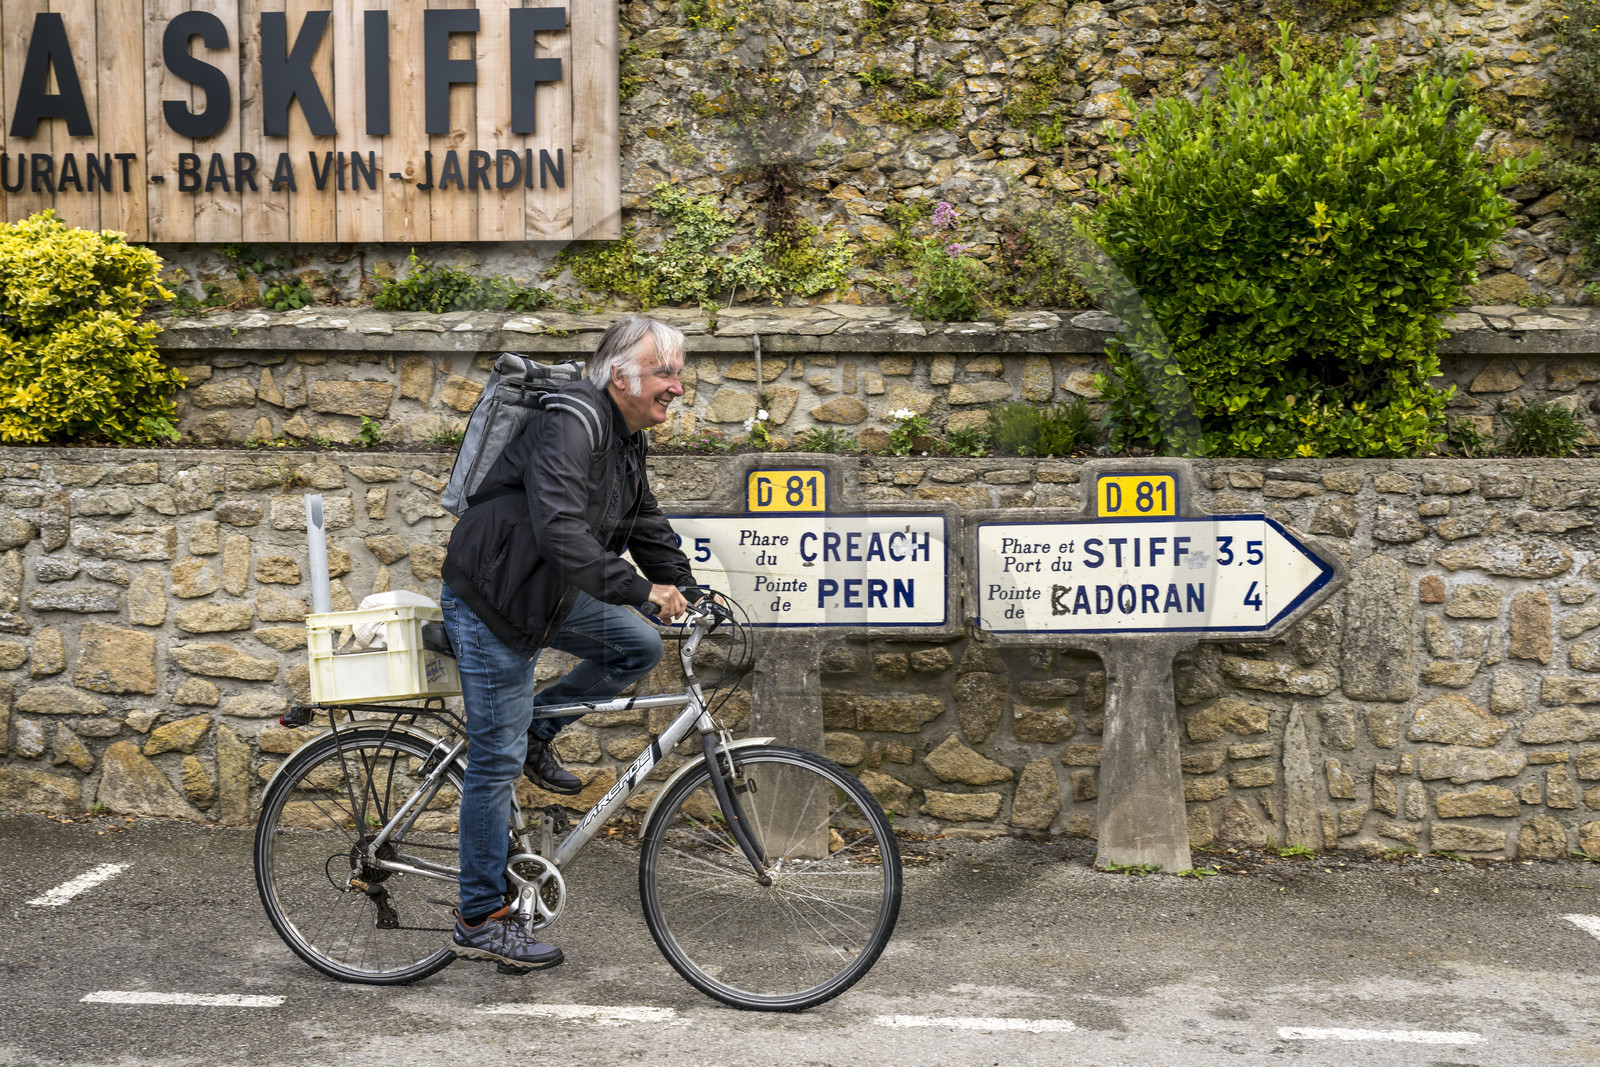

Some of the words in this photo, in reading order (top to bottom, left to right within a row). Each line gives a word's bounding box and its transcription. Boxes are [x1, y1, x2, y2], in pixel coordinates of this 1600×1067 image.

[10, 12, 93, 137] A
[162, 7, 566, 139] SKIFF
[1, 152, 136, 193] URANT
[178, 152, 258, 193] BAR
[271, 151, 297, 192] A
[309, 150, 376, 191] VIN
[416, 148, 565, 191] JARDIN
[757, 477, 773, 507] D
[785, 475, 818, 507] 81
[1106, 482, 1122, 513] D
[1135, 480, 1168, 513] 81
[738, 530, 789, 547] Phare
[1001, 537, 1051, 554] Phare
[1058, 539, 1075, 554] et
[755, 550, 778, 566] du
[1082, 536, 1192, 569] STIFF
[1215, 535, 1265, 567] 3,5
[1003, 556, 1042, 573] Port
[1050, 555, 1073, 573] du
[753, 575, 808, 593] Pointe
[987, 584, 1042, 601] Pointe
[817, 578, 916, 609] PERN
[1243, 580, 1264, 612] 4
[770, 596, 792, 612] de
[1004, 603, 1026, 620] de
